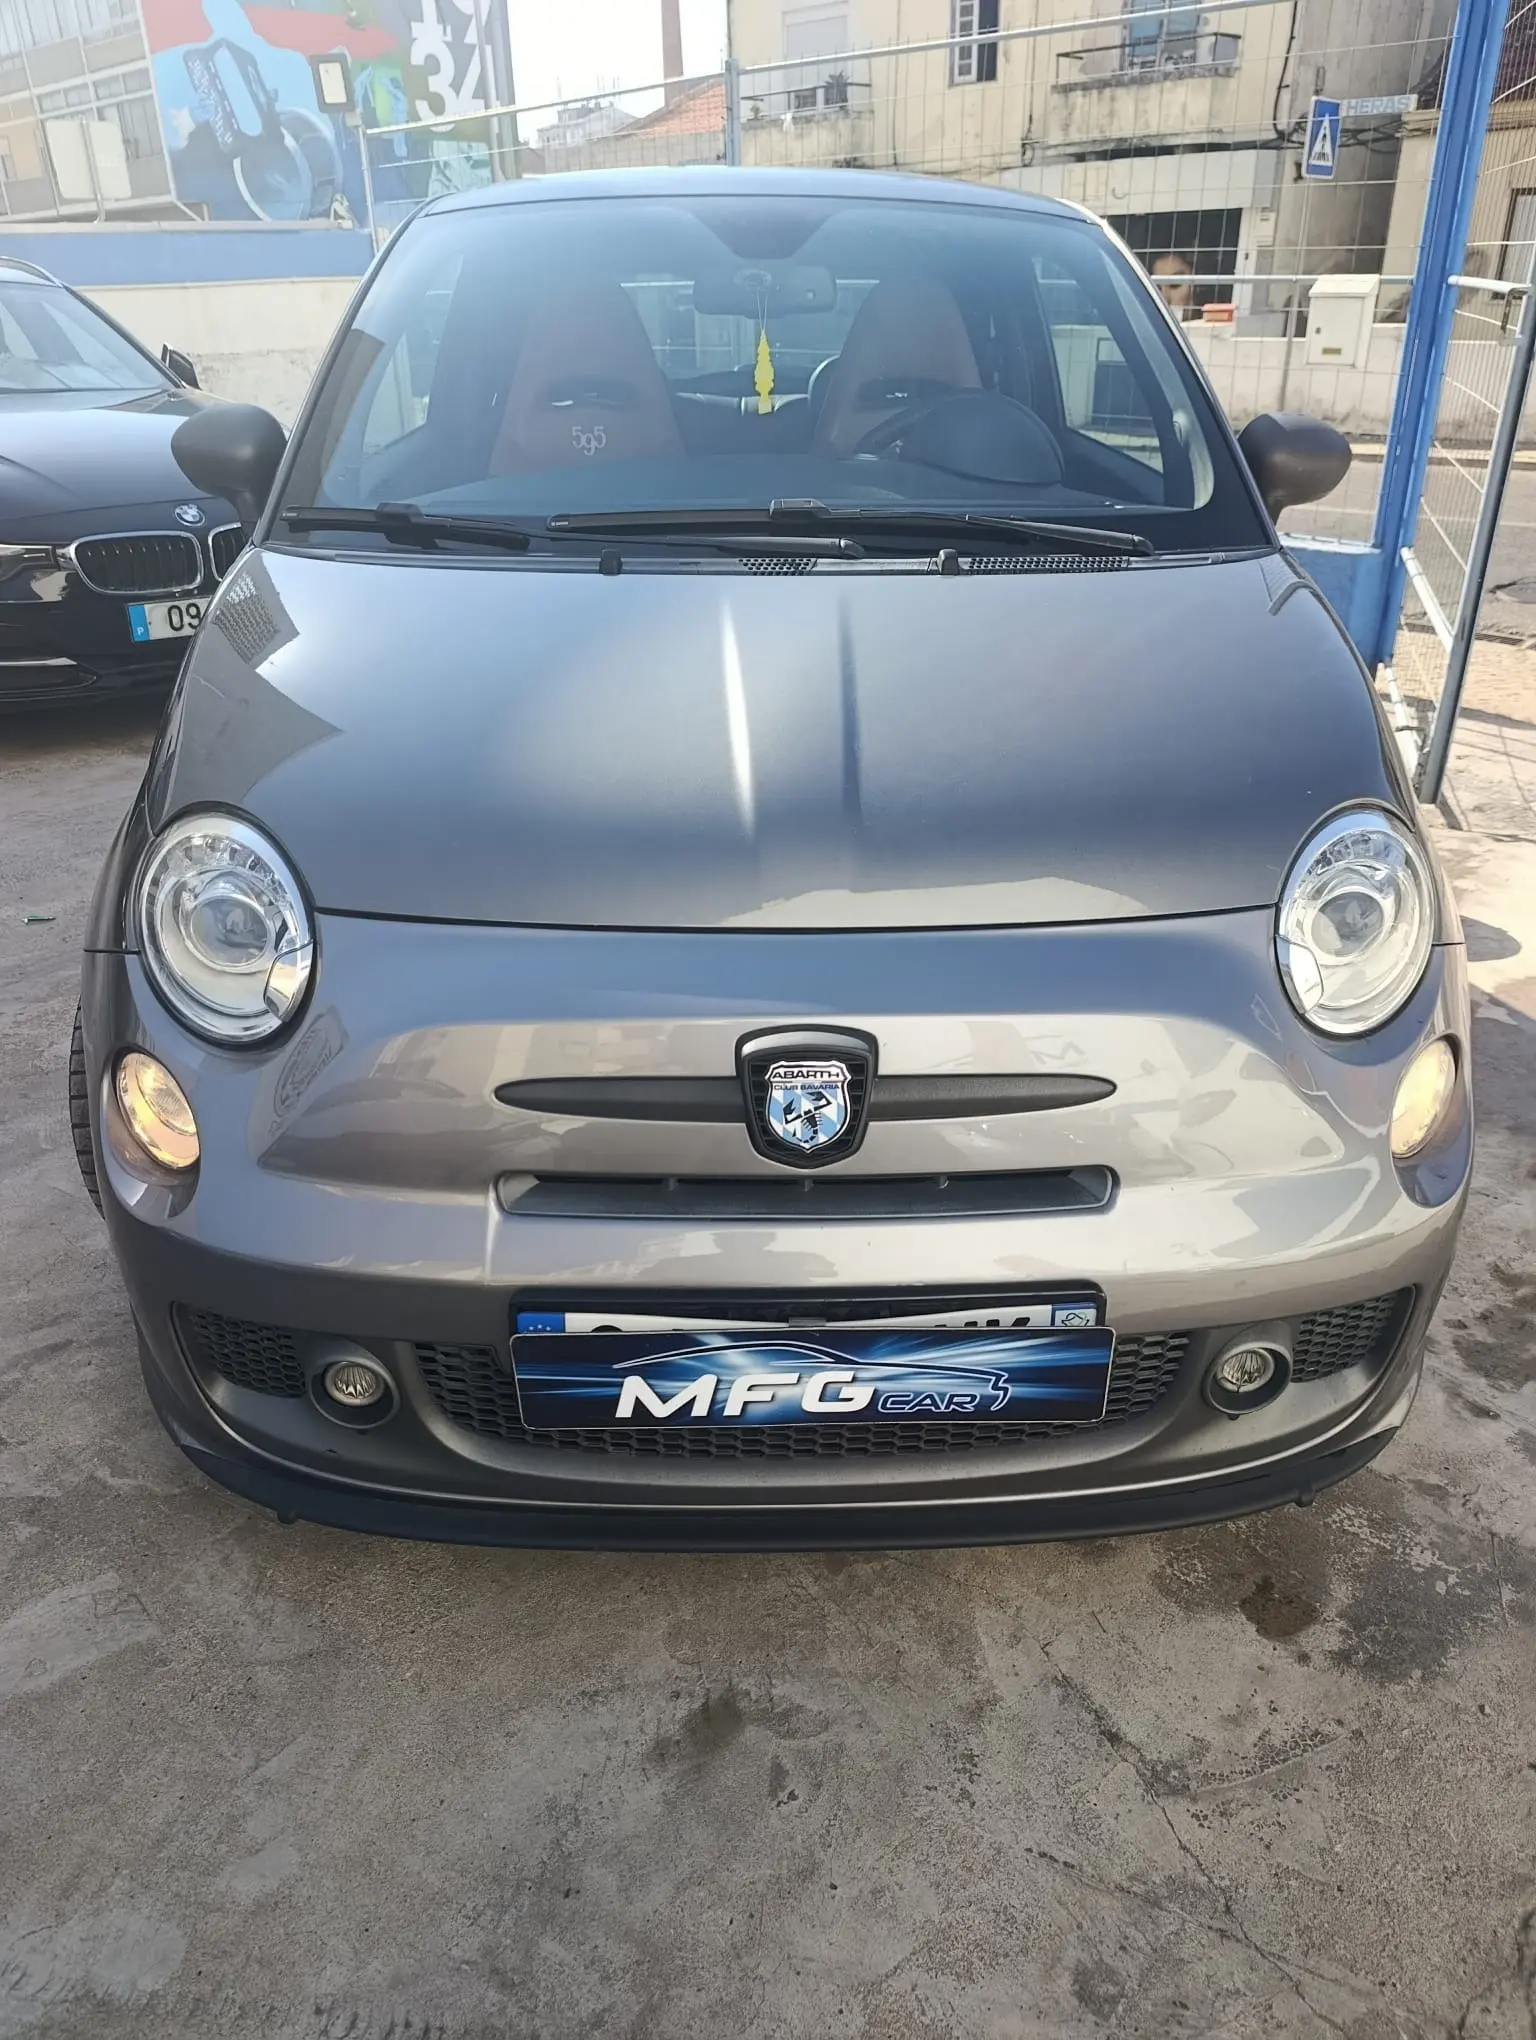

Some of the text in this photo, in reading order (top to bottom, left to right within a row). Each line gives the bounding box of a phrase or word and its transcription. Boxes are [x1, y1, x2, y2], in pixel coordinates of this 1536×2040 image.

[1346, 97, 1409, 116] HERAS
[572, 426, 607, 456] 595
[168, 602, 201, 632] 09
[772, 1070, 840, 1079] ABARTH
[615, 1370, 980, 1418] MFG CAR
